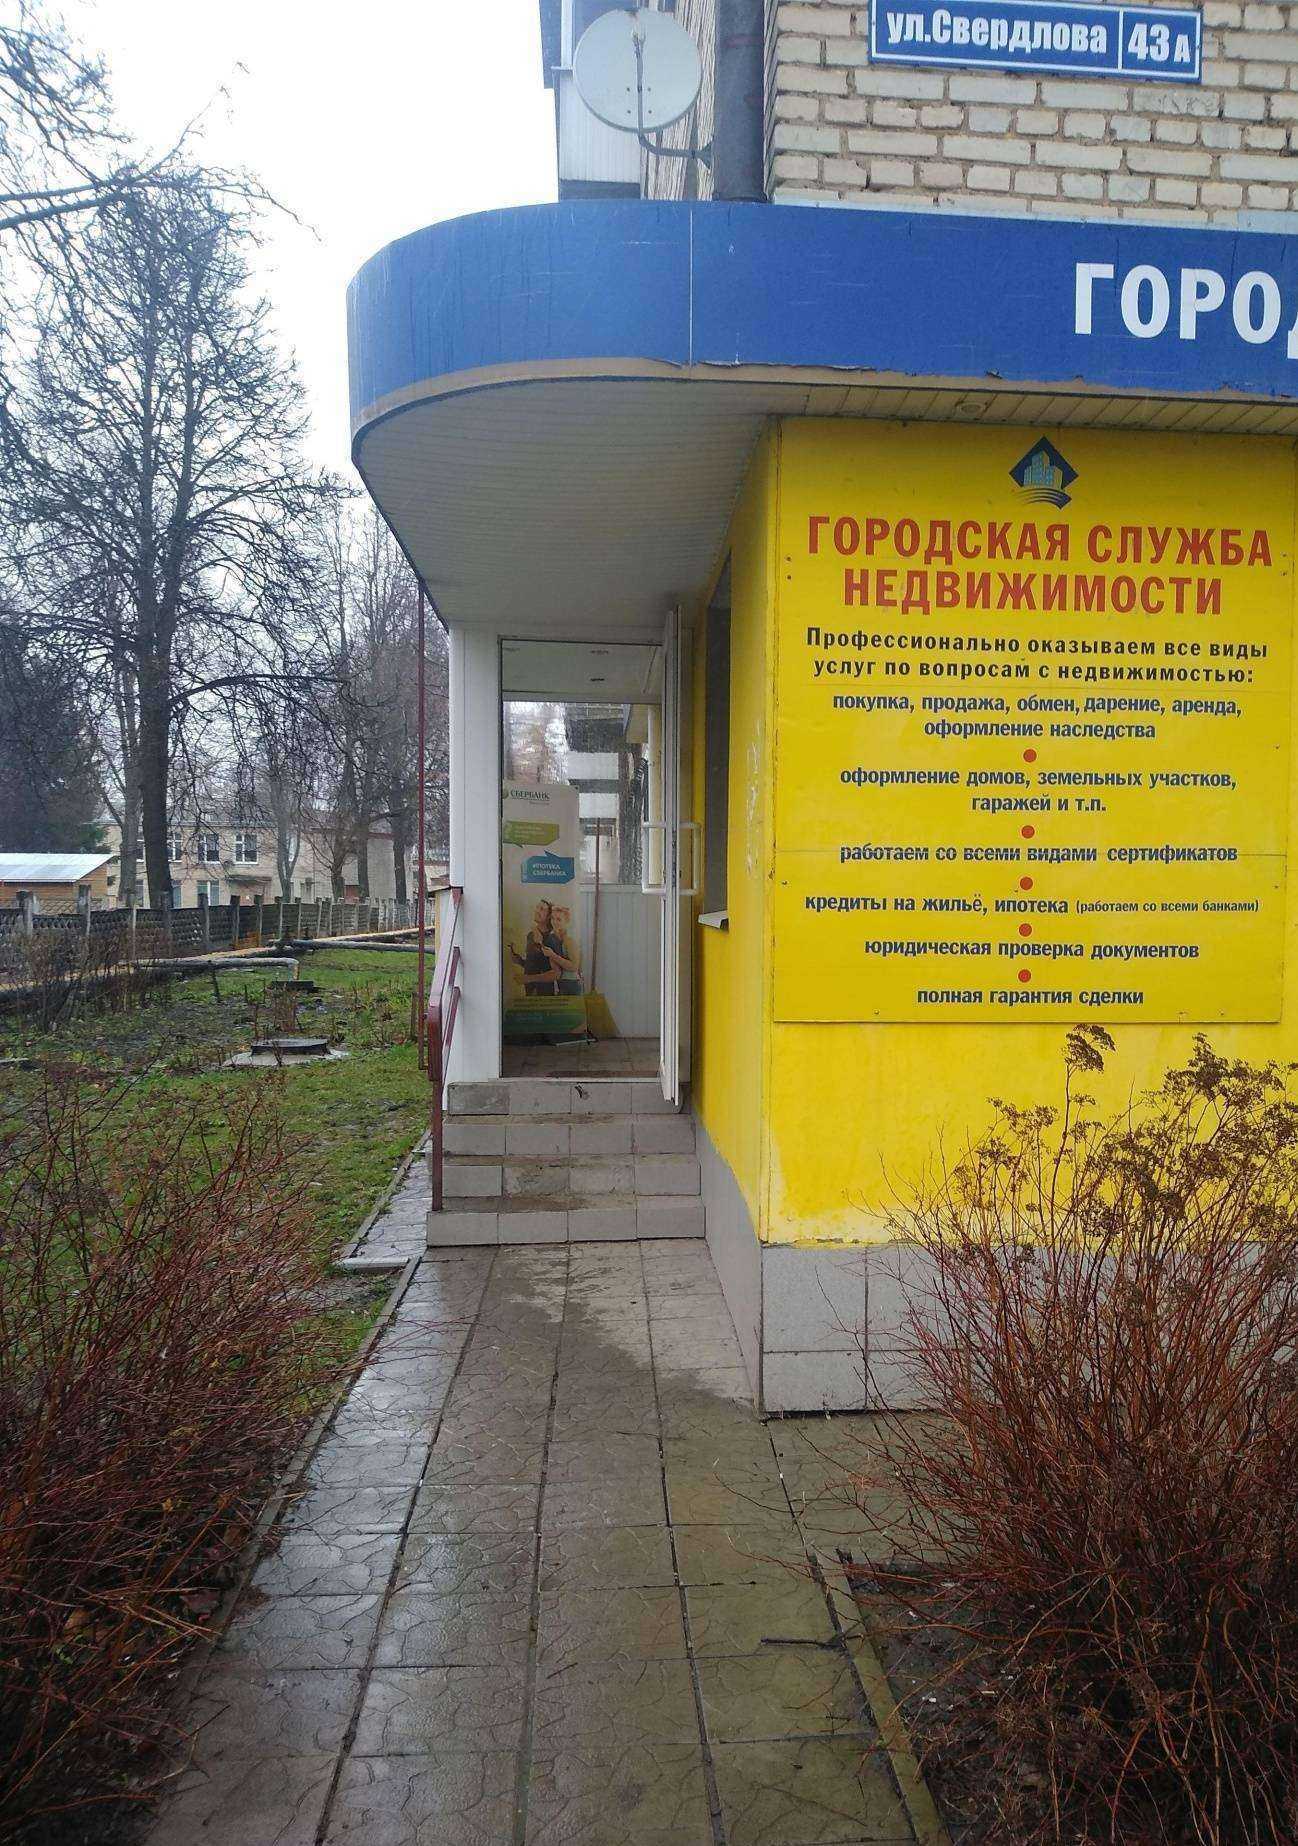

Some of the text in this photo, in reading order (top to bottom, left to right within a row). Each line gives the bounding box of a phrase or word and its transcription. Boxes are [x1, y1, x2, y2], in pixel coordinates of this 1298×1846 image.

[808, 516, 1272, 566] ГОРОДСКАЯ СЛУЖБА
[844, 568, 1222, 616] НЕДВИЖИМОСТИ
[807, 627, 1267, 660] Профессионально оказываем все виды
[813, 660, 1253, 683] услуг по вопросам с недвижимостью:
[833, 695, 1243, 718] покупка, продажа, обмен, дарение, аренда,
[924, 718, 1156, 741] оформление наследства
[840, 766, 1237, 791] оформление домов, земельных участков,
[972, 793, 1107, 814] гаражей и т.п.
[840, 842, 1238, 865] работаем со всеми видами сертификатов
[805, 893, 1259, 916] кредиты на жильё, ипотека (работаем со всеми банками)
[864, 940, 1200, 962] юридическая проверка документов
[917, 990, 1144, 1007] полная гарантия сделки
